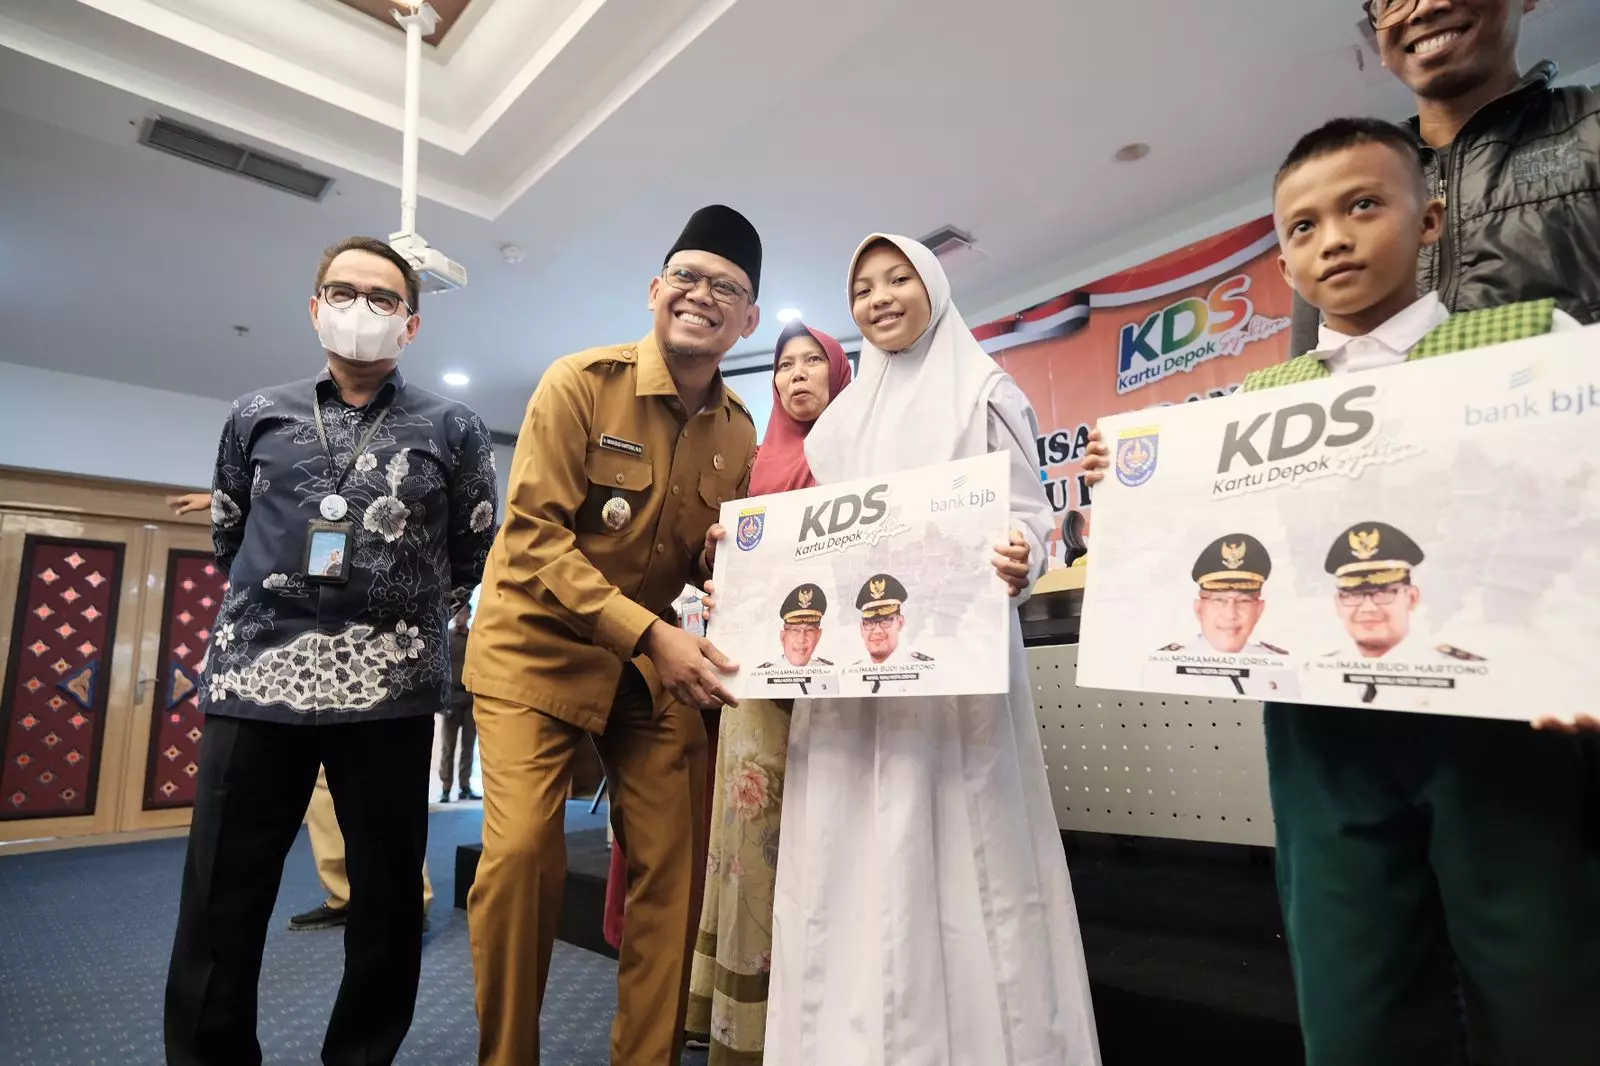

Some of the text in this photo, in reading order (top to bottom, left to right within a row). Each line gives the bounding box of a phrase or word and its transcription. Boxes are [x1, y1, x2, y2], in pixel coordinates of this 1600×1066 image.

[1120, 276, 1247, 373] KDS
[1118, 364, 1160, 390] Kartu
[1164, 341, 1216, 371] Depok
[1216, 385, 1376, 474] KDS
[1464, 394, 1539, 426] bank
[1212, 472, 1263, 495] Kartu
[1267, 455, 1330, 482] Depok
[798, 484, 888, 542] KDS
[930, 488, 996, 512] bank bjb
[794, 541, 825, 556] Kartu
[827, 529, 863, 547] Depok
